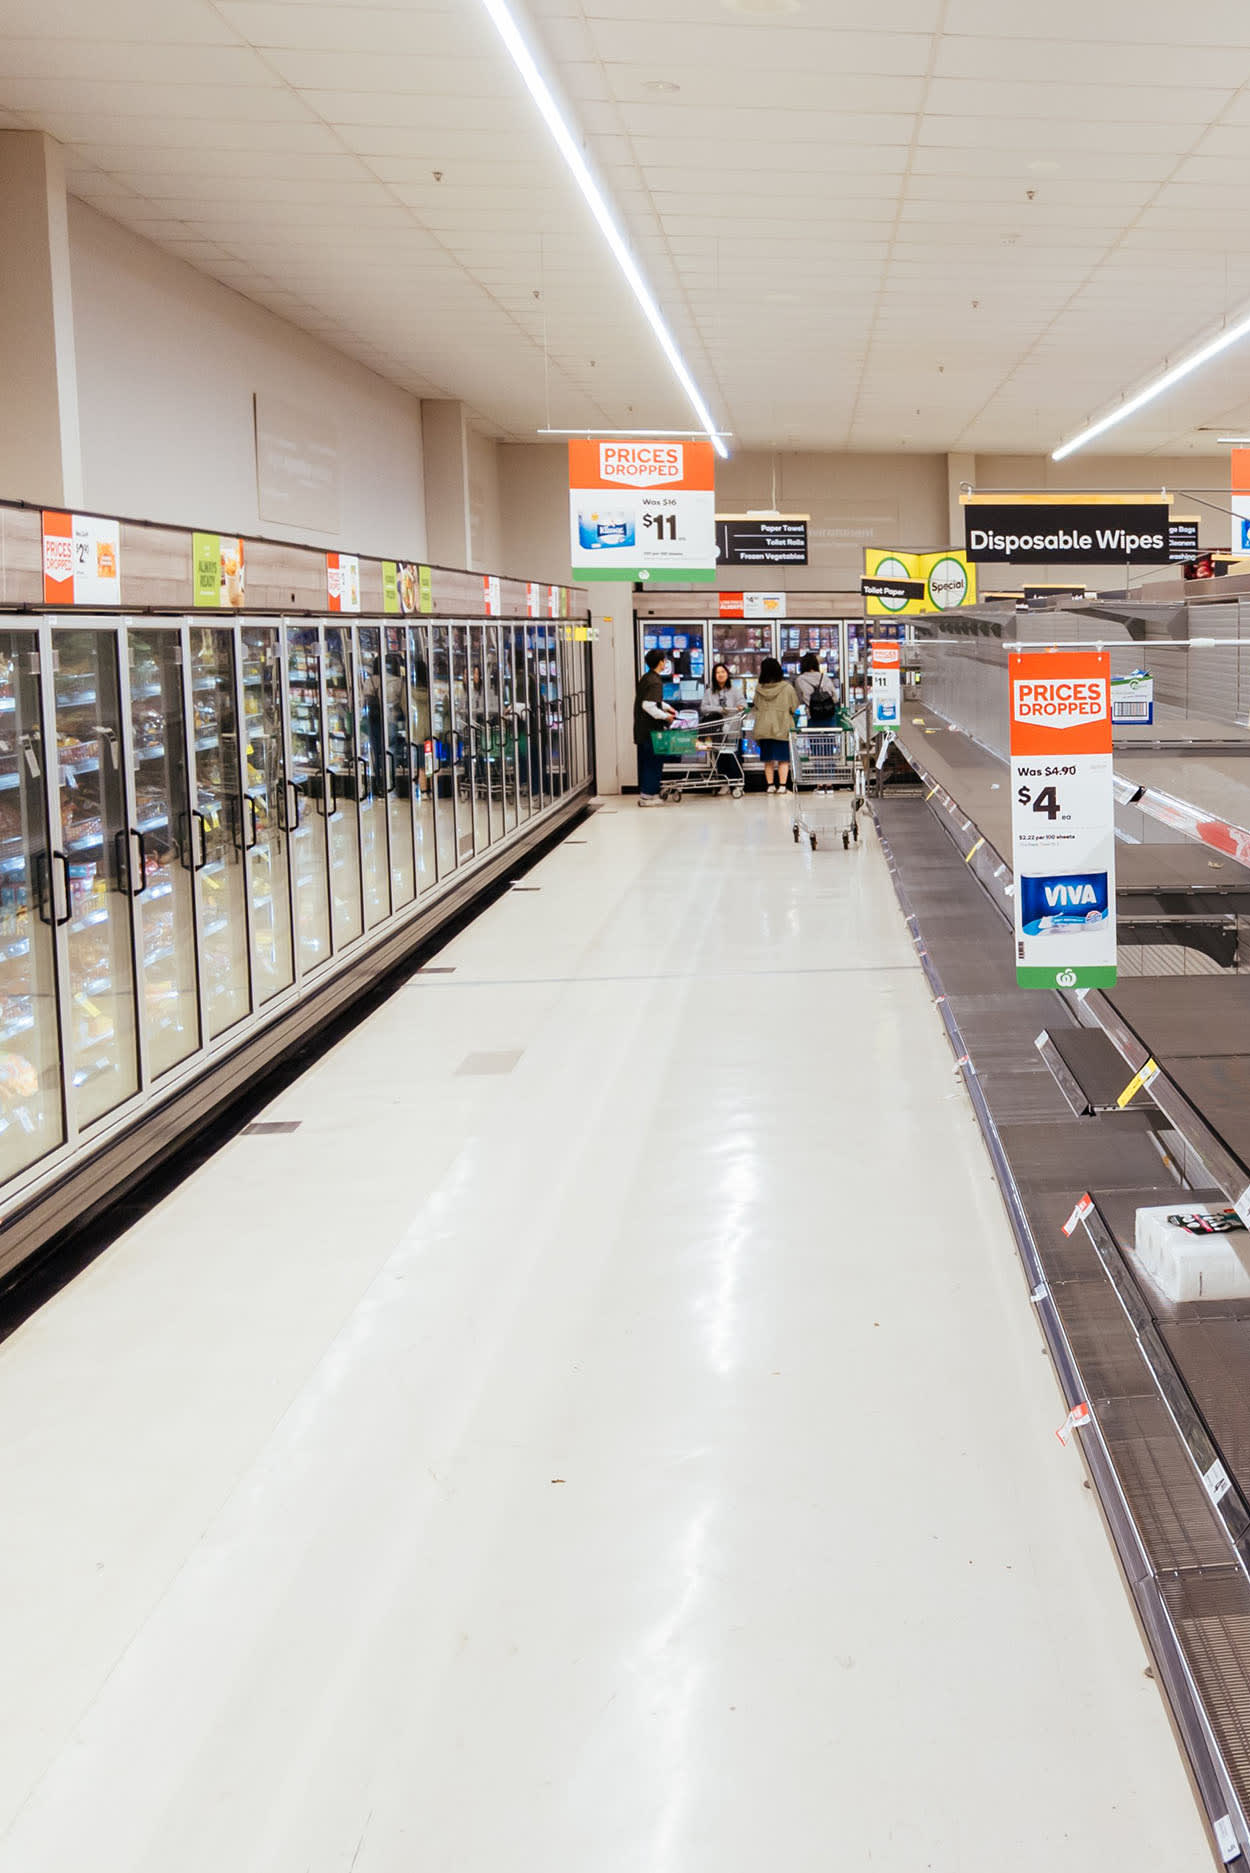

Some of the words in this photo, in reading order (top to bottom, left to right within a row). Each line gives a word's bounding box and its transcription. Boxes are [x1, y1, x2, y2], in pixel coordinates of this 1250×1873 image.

[604, 447, 679, 464] PRICES
[604, 463, 679, 477] DROPPED
[642, 498, 661, 506] Was
[642, 513, 677, 541] $11
[760, 524, 782, 533] Paper
[783, 524, 805, 533] Towel
[46, 540, 71, 558] PRICES
[766, 538, 787, 546] Toilet
[787, 538, 805, 546] Rolls
[970, 529, 1093, 556] Disposable
[1095, 529, 1164, 555] Wipes
[739, 552, 765, 560] Frozen
[765, 552, 805, 561] Vegetables
[863, 585, 883, 595] Toilet
[884, 587, 905, 597] Paper
[931, 579, 965, 593] Special
[1019, 683, 1102, 702] PRICES
[1019, 701, 1102, 717] DROPPED
[1017, 767, 1042, 777] Was
[1044, 764, 1077, 777] $4.90
[1017, 784, 1061, 821] $4
[1044, 883, 1098, 908] VIVA
